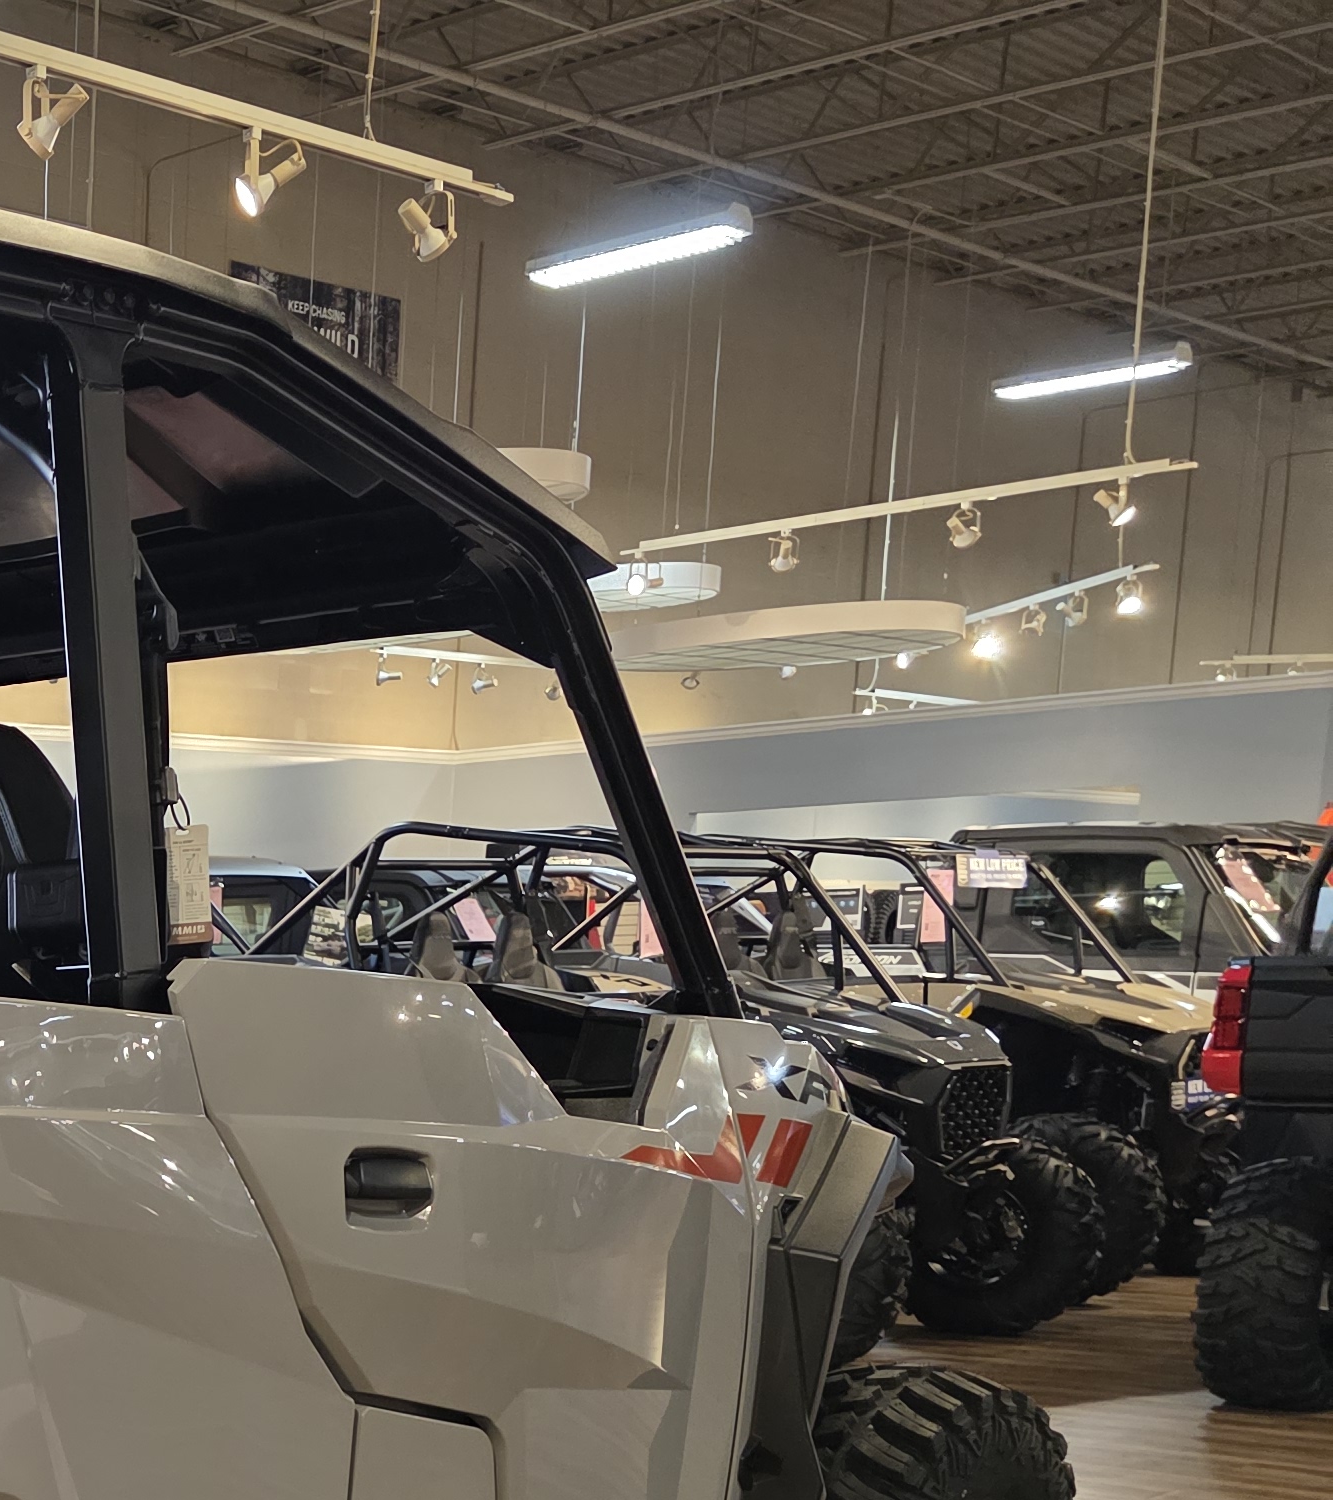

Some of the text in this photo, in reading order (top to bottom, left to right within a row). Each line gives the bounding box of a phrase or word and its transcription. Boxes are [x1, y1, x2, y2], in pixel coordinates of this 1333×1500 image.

[288, 300, 345, 324] KEEP CHASING
[1001, 858, 1025, 872] PRICE
